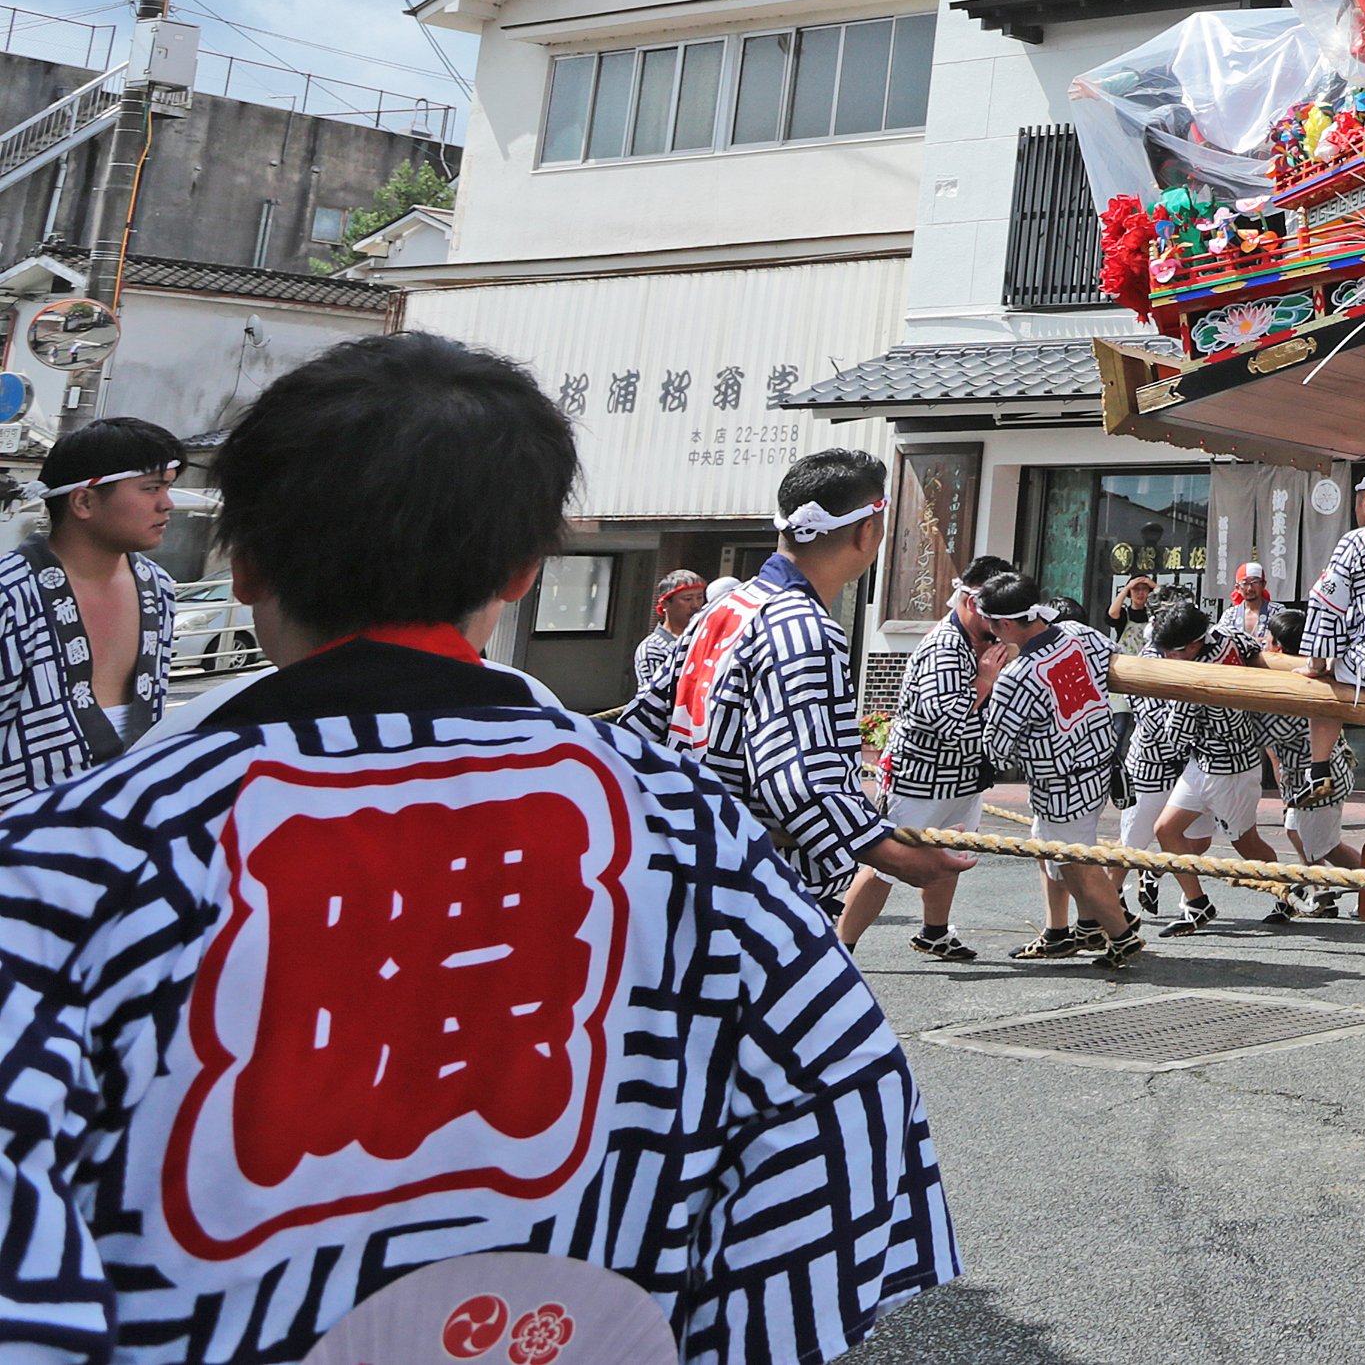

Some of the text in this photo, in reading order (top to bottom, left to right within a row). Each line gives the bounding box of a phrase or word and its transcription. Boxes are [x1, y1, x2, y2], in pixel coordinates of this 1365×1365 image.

[687, 447, 798, 467] 中央店 24-1678
[735, 424, 800, 445] 22-2358
[52, 595, 95, 709] 祇園祭
[137, 590, 158, 702] 三隈町
